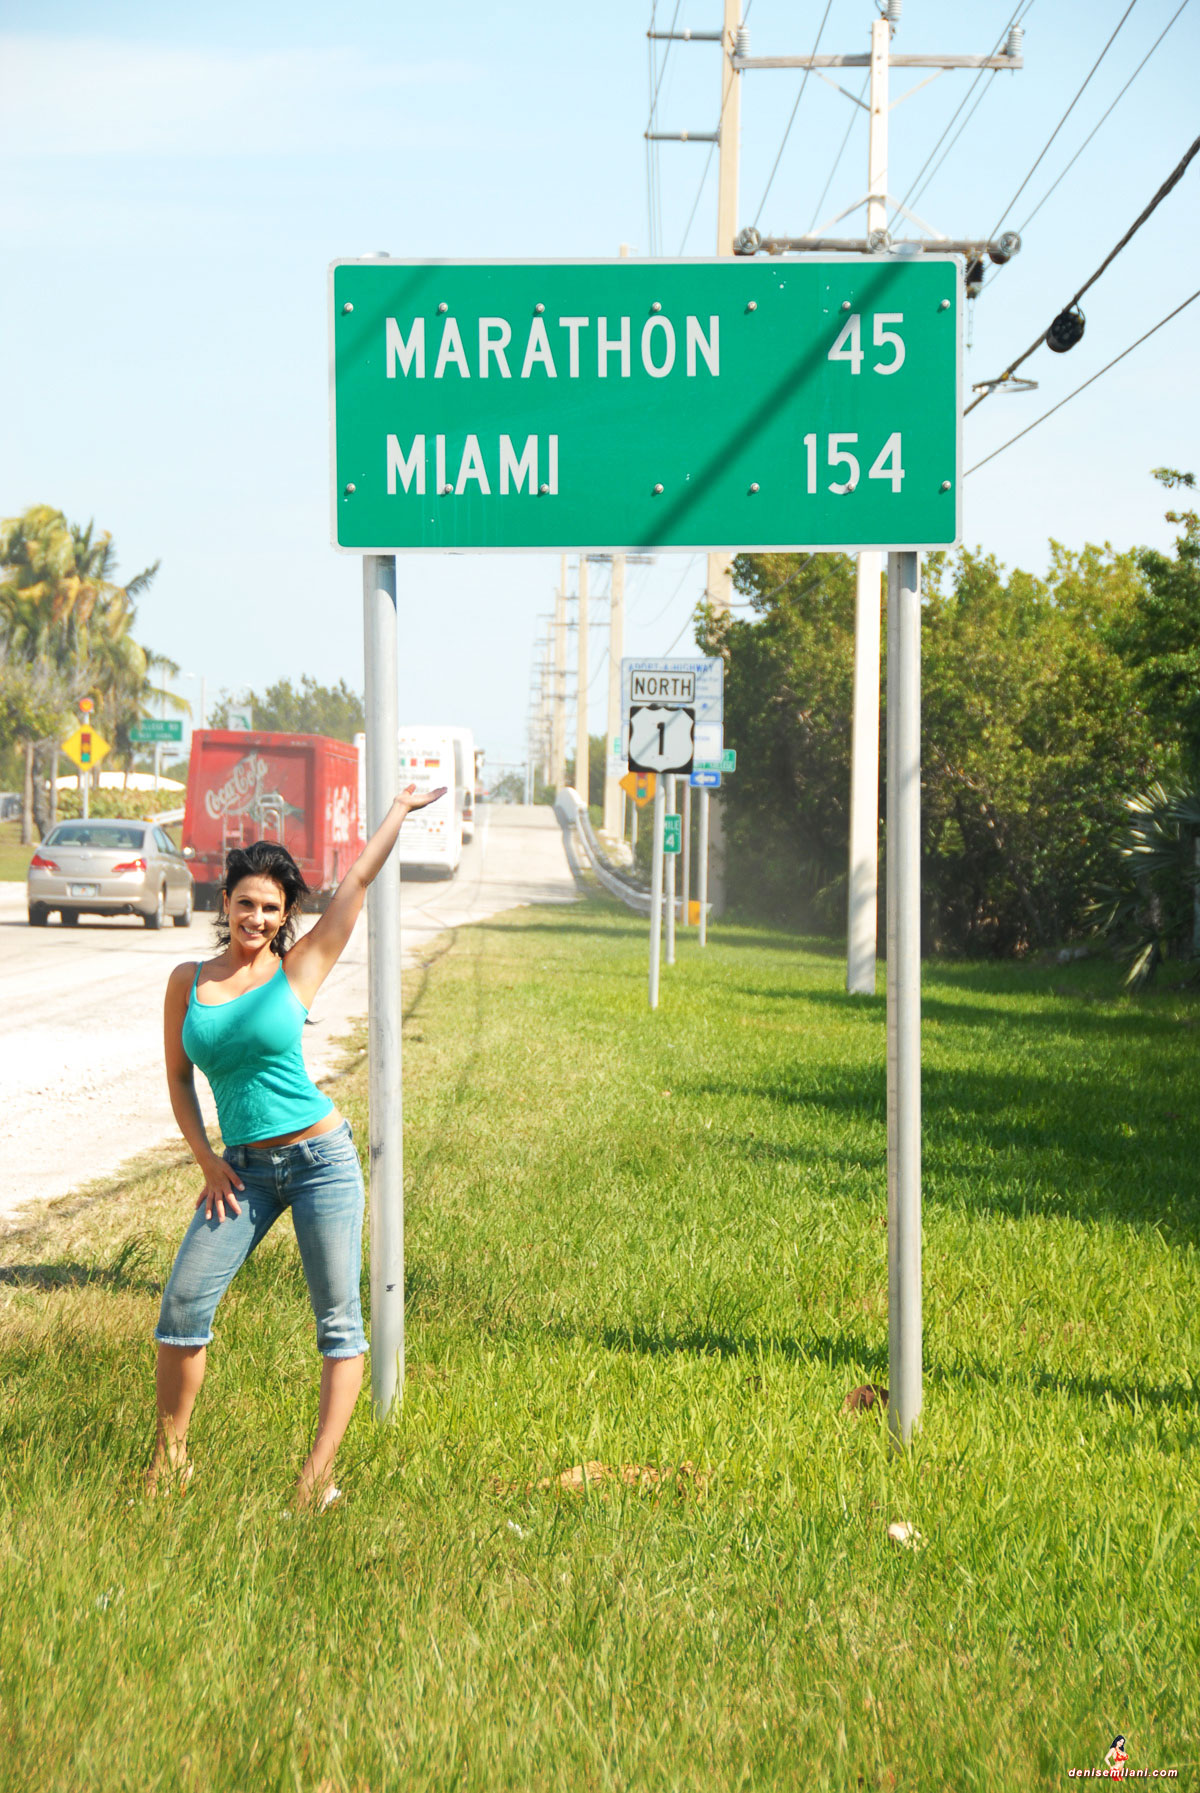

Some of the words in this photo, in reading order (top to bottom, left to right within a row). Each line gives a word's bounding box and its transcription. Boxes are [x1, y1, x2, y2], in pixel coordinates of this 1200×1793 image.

[385, 315, 721, 379] MARATHON
[828, 312, 907, 376] 45
[386, 433, 560, 496] MIAMI
[803, 432, 906, 495] 154
[634, 677, 692, 696] NORTH
[656, 721, 666, 756] 1
[665, 833, 675, 848] 4
